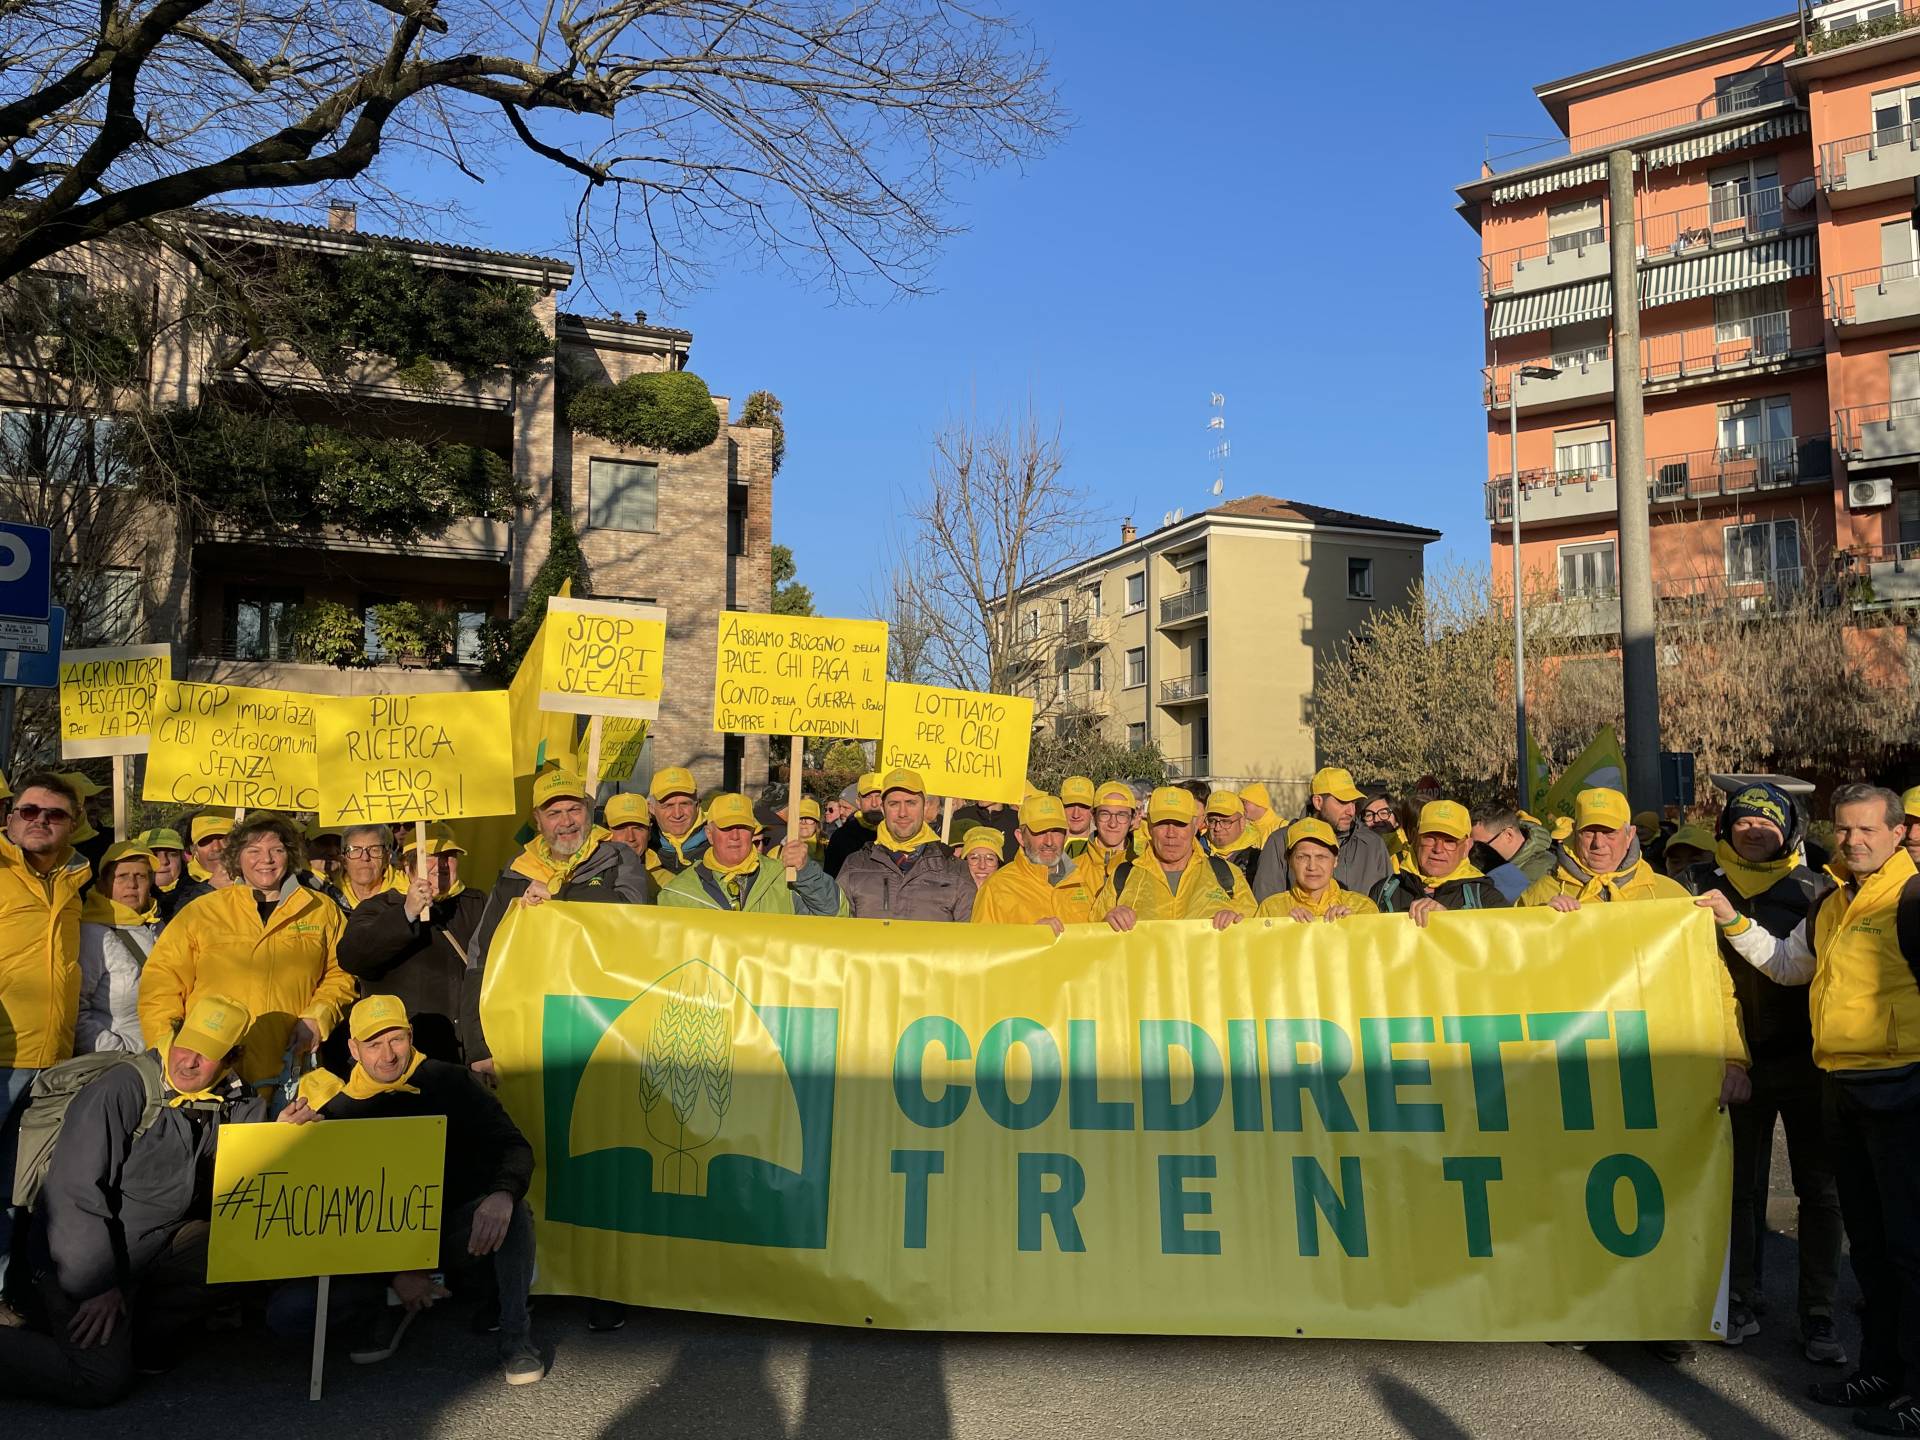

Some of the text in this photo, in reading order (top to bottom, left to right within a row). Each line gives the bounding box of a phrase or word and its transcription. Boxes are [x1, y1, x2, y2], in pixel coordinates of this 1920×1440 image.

[568, 614, 635, 644] STOP
[788, 632, 845, 652] BISOGNO
[852, 644, 880, 654] DELLA
[561, 641, 657, 673] IMPORT
[722, 649, 767, 674] PACE.
[777, 651, 802, 678] CHI
[812, 655, 850, 684] PAGA
[63, 657, 163, 690] AGRICOLTORI
[557, 667, 649, 696] SLEALE
[78, 682, 158, 714] PESCATOR
[164, 682, 317, 727] STOP importazi
[720, 679, 769, 705] CONTO
[770, 695, 797, 706] DELLA
[806, 682, 857, 711] GUERRA
[914, 691, 1006, 723] LOTTIAMO
[99, 715, 121, 736] LA
[122, 710, 154, 737] PA
[158, 716, 197, 745] CIBI
[717, 708, 766, 731] SEMPRE
[789, 707, 860, 735] CONTADINI
[915, 720, 1000, 750] PER CIBI
[345, 724, 455, 761] RICERCA
[199, 749, 276, 782] SENZA
[885, 744, 1002, 778] SENZA RISCHI
[171, 773, 319, 811] CONTROLLO
[365, 767, 432, 793] MENO
[893, 1010, 1658, 1133] COLDIRETTI
